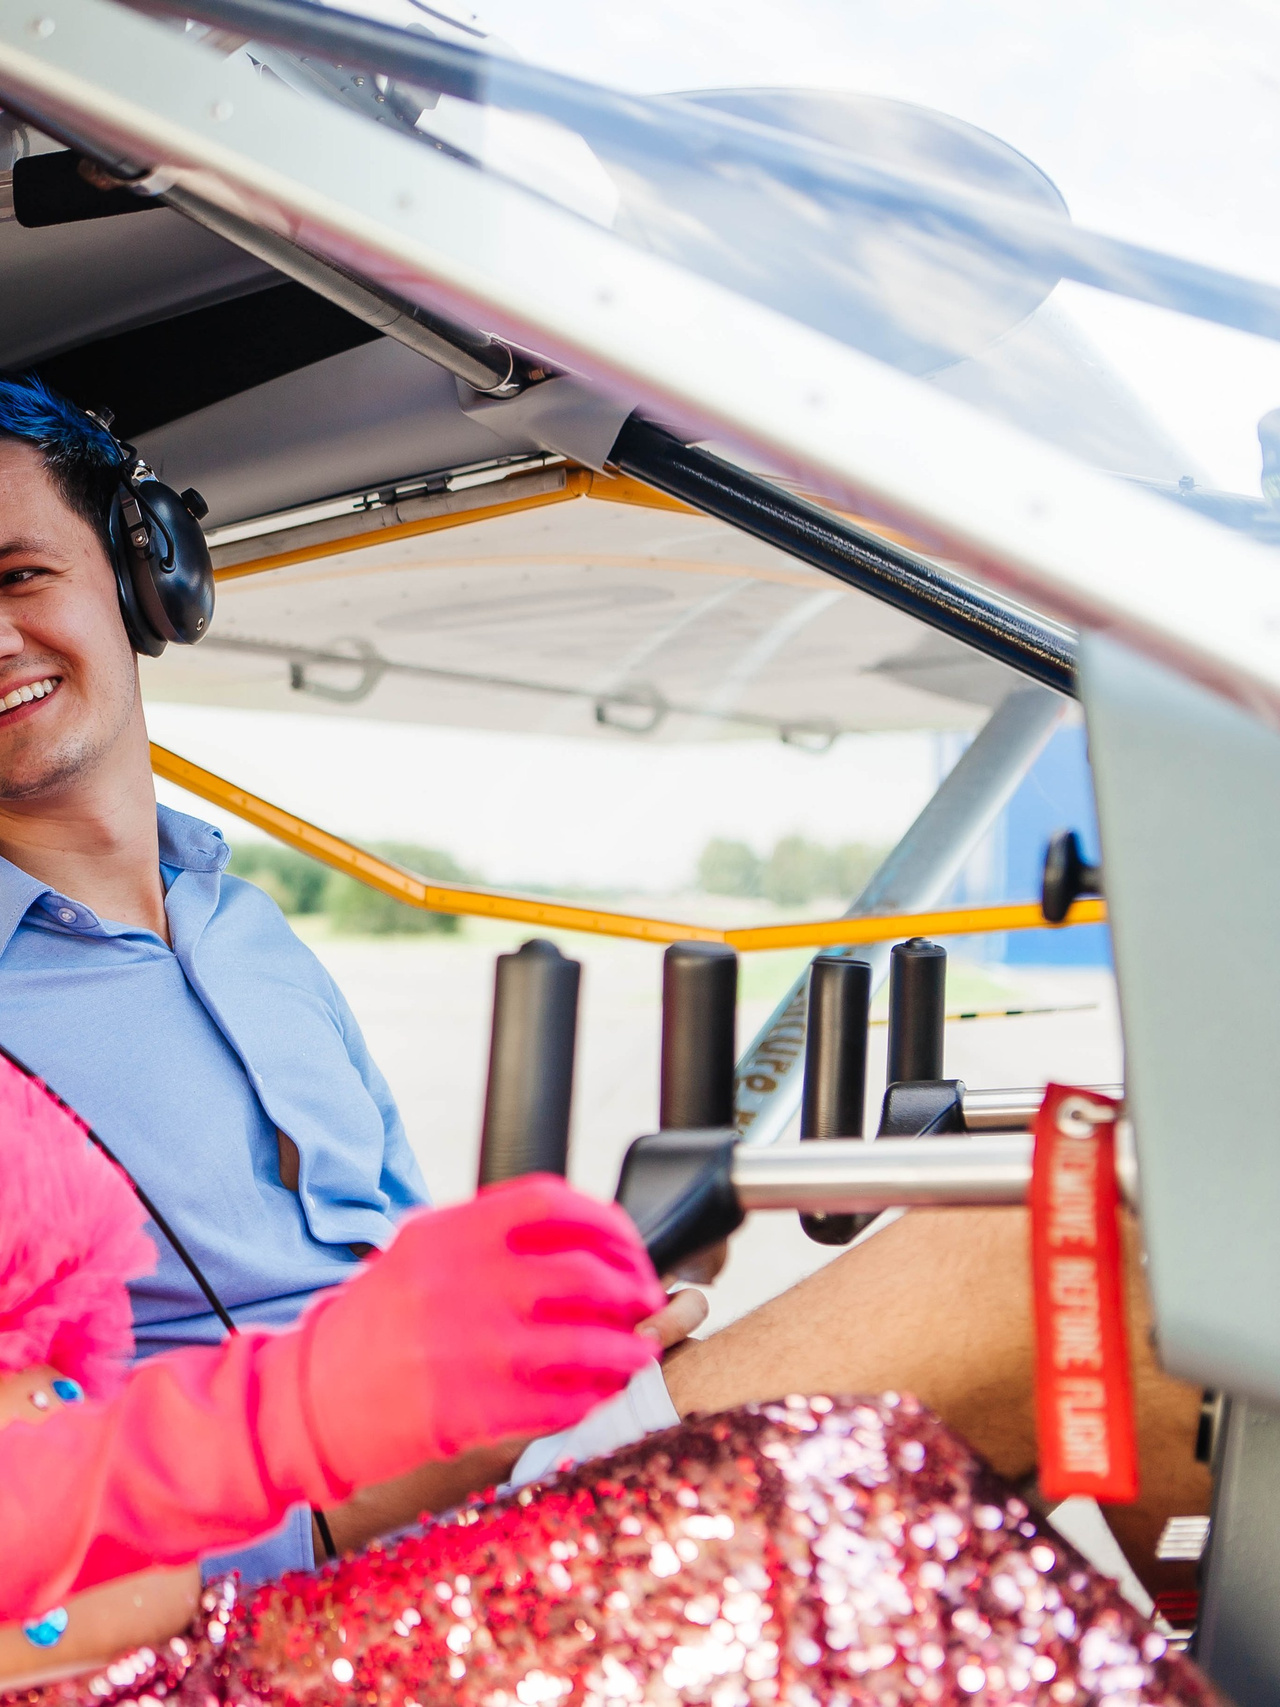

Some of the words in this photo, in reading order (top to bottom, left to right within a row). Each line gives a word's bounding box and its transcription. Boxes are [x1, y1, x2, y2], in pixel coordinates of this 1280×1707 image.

[1050, 1137, 1099, 1247] REMOVE
[1049, 1256, 1103, 1371] BEFORE
[1055, 1376, 1110, 1478] FLIGHT
